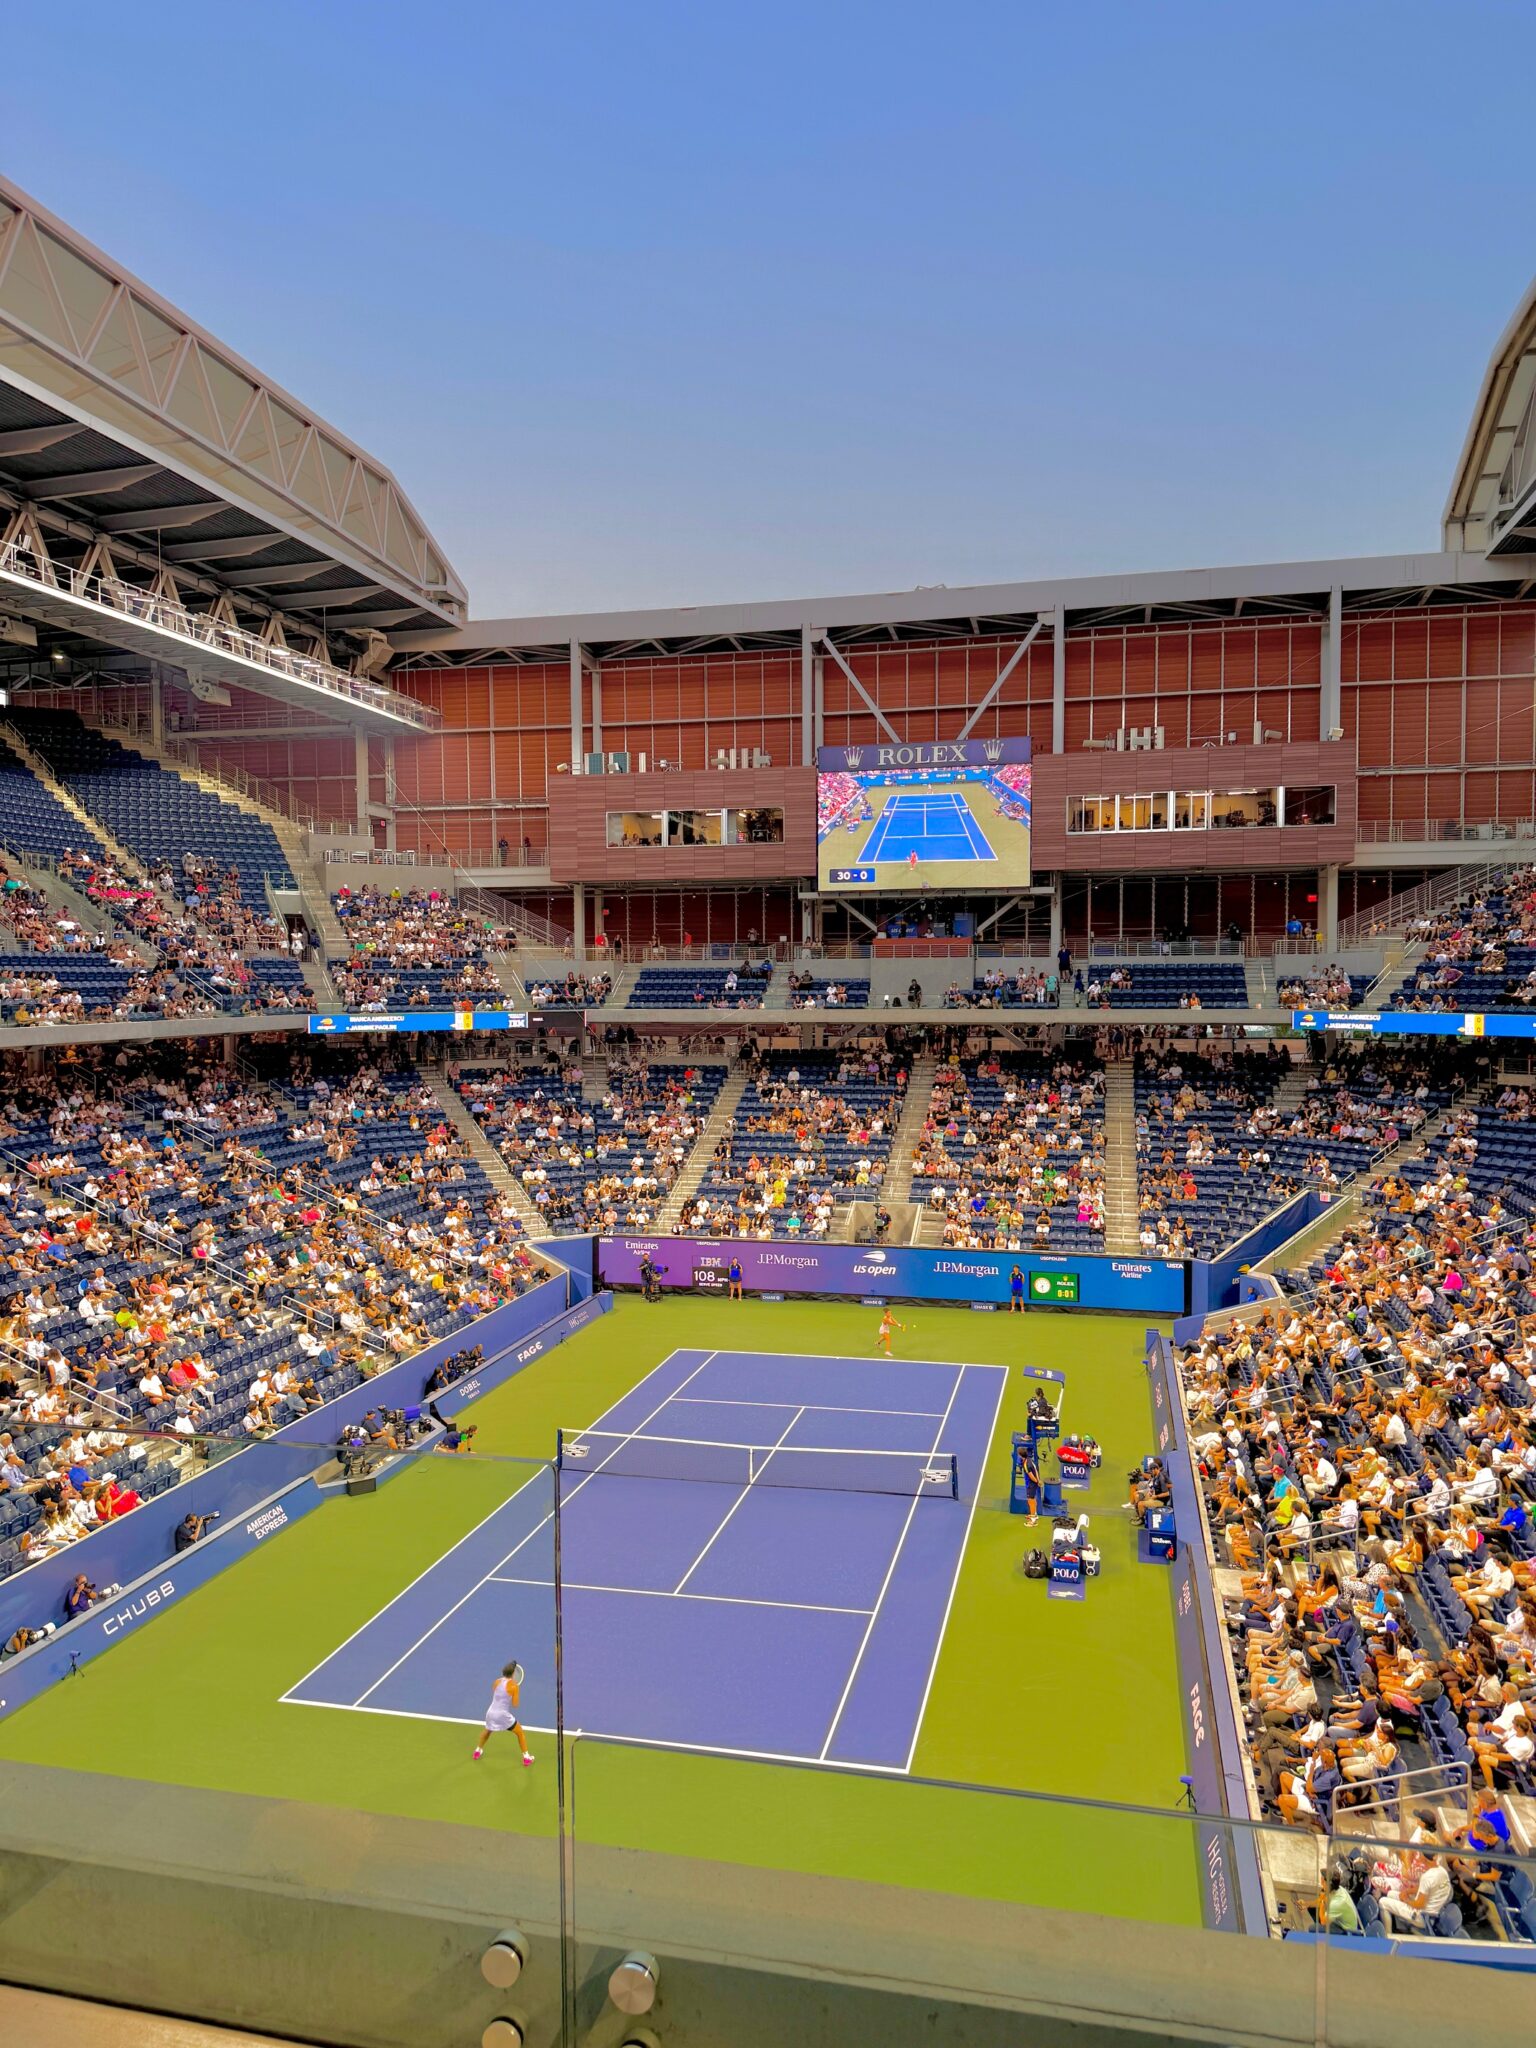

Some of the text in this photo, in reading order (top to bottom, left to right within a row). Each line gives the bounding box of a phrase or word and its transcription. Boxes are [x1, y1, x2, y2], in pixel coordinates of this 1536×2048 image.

[878, 744, 968, 766] ROLEX
[836, 872, 850, 880] 30
[860, 870, 868, 880] 0
[625, 1240, 658, 1250] Emirates
[700, 1256, 722, 1267] IBM
[1112, 1262, 1152, 1272] Emirates
[694, 1270, 715, 1282] 108
[853, 1264, 896, 1276] us open
[460, 1380, 480, 1396] DOBEL
[1063, 1466, 1086, 1476] POLO
[246, 1504, 284, 1535] AMERICAN
[254, 1512, 288, 1540] EXPRESS
[1053, 1568, 1079, 1578] POLO
[102, 1580, 175, 1635] CHUBB
